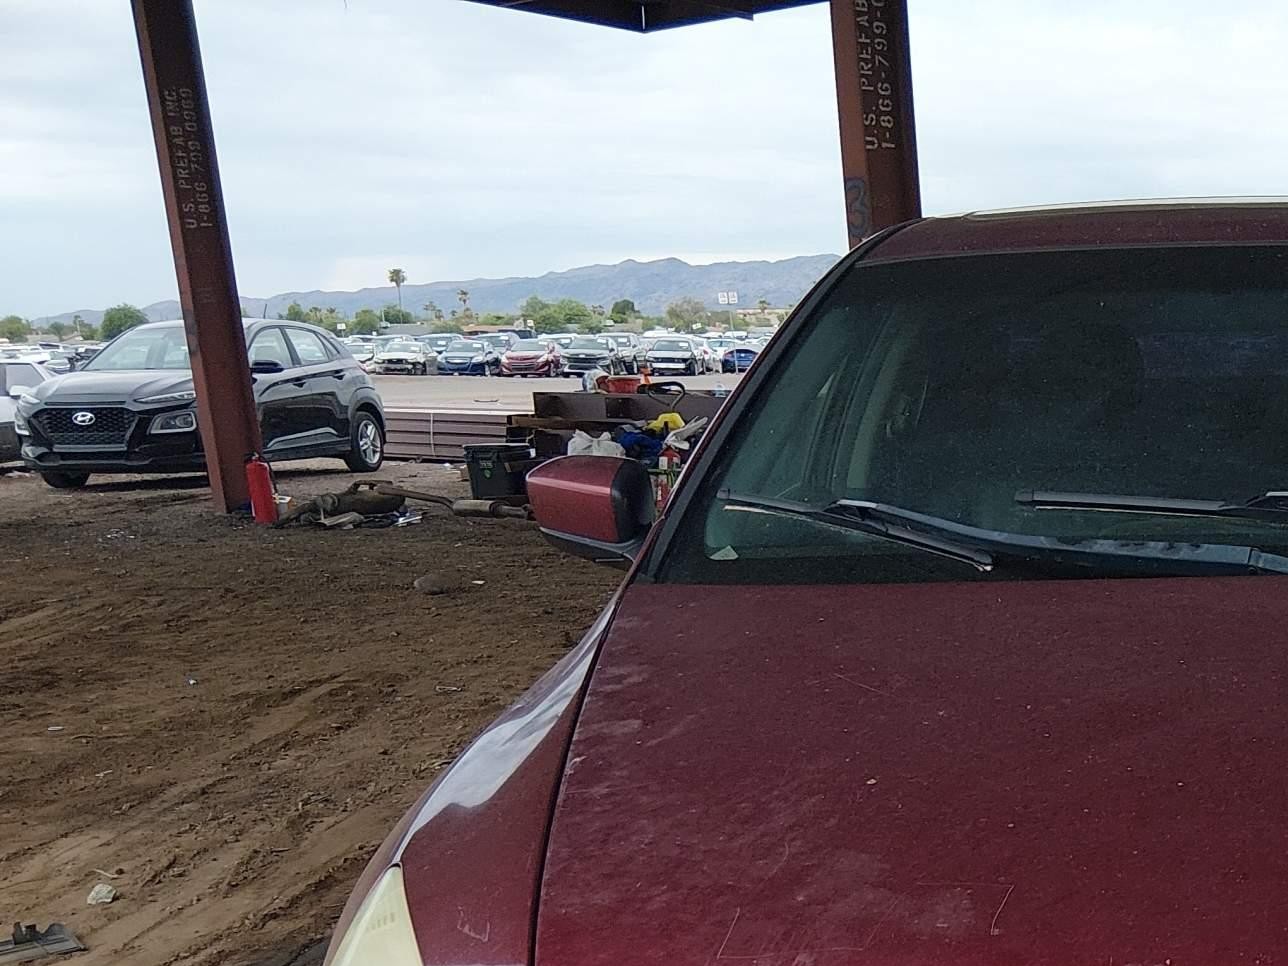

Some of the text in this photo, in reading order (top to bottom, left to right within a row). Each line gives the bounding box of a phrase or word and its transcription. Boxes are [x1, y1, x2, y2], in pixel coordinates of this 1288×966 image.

[855, 0, 879, 150] U.S. PREFAB
[169, 126, 193, 189] PREFAB
